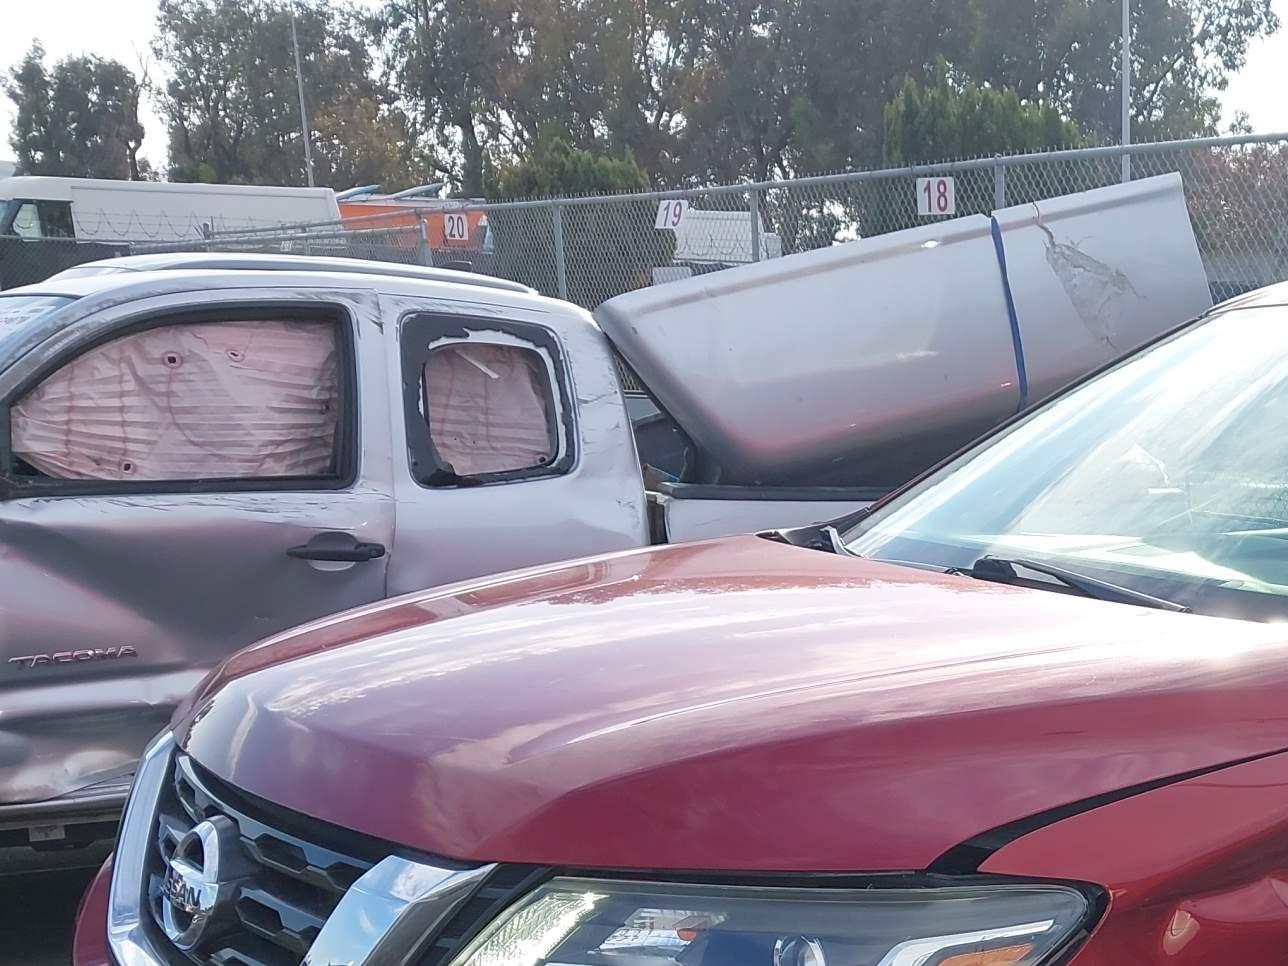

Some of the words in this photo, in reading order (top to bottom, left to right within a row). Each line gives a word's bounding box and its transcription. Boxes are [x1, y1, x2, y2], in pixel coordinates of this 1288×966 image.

[923, 179, 949, 213] 18
[447, 215, 465, 239] 20
[663, 201, 683, 228] 19
[8, 645, 138, 669] TACOMA
